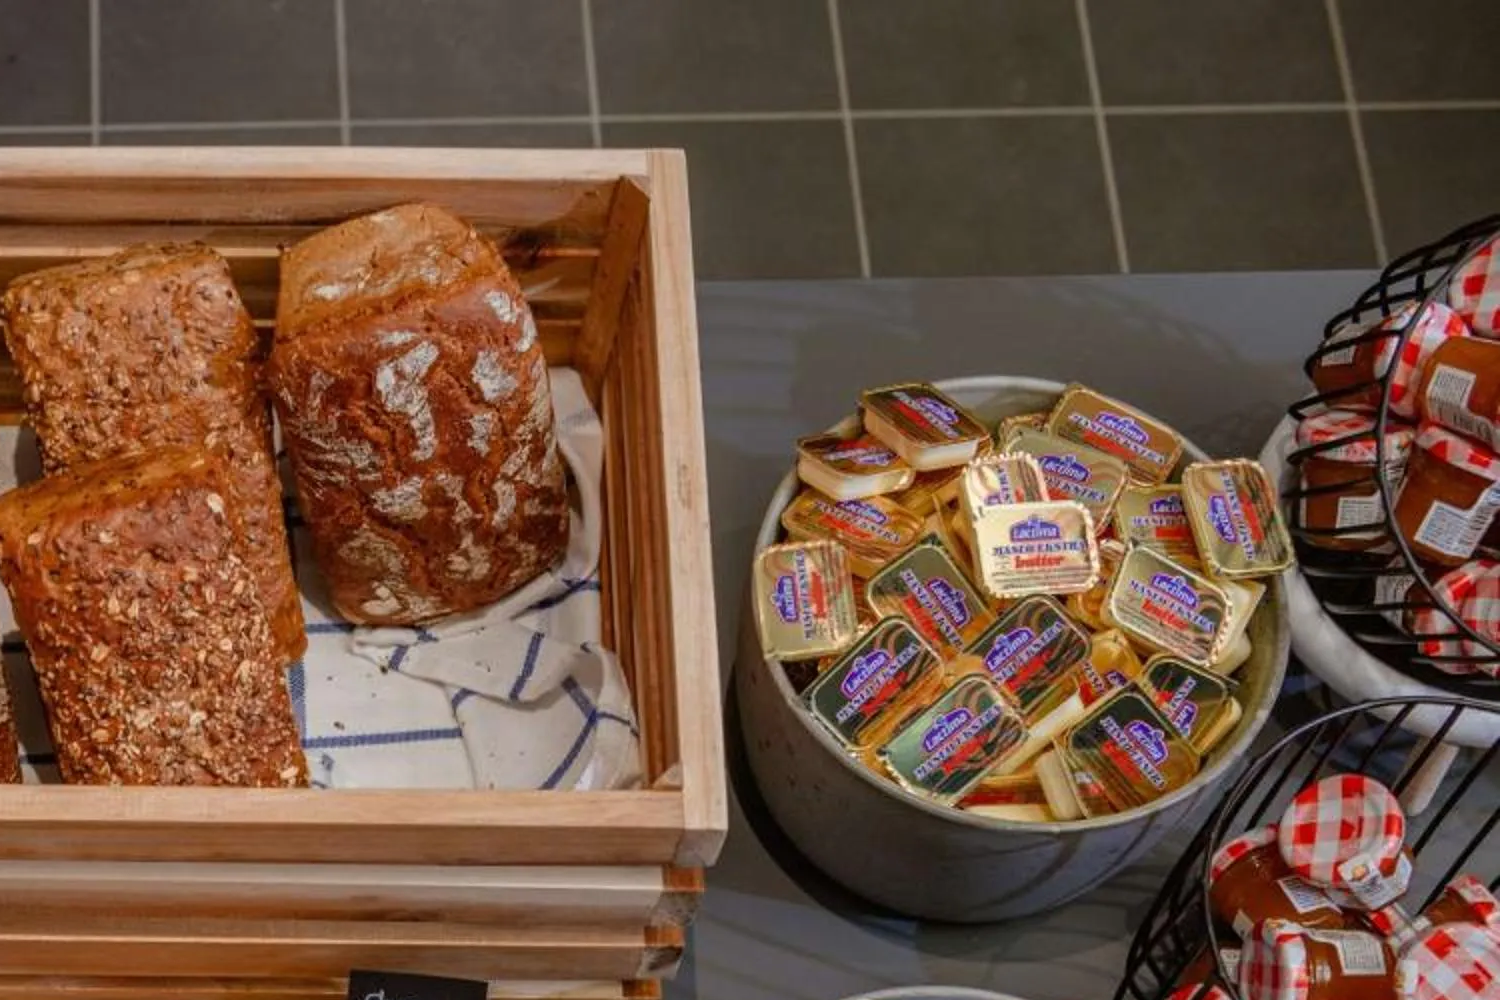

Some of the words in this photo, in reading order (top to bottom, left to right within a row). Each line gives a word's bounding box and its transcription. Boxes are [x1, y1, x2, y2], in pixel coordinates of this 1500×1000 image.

[1013, 526, 1057, 539] Lactima
[1015, 554, 1064, 567] butter
[1151, 575, 1199, 607] Lactima
[985, 630, 1032, 671] Lactima
[842, 652, 890, 694] Lactima
[923, 710, 971, 750] Lactima
